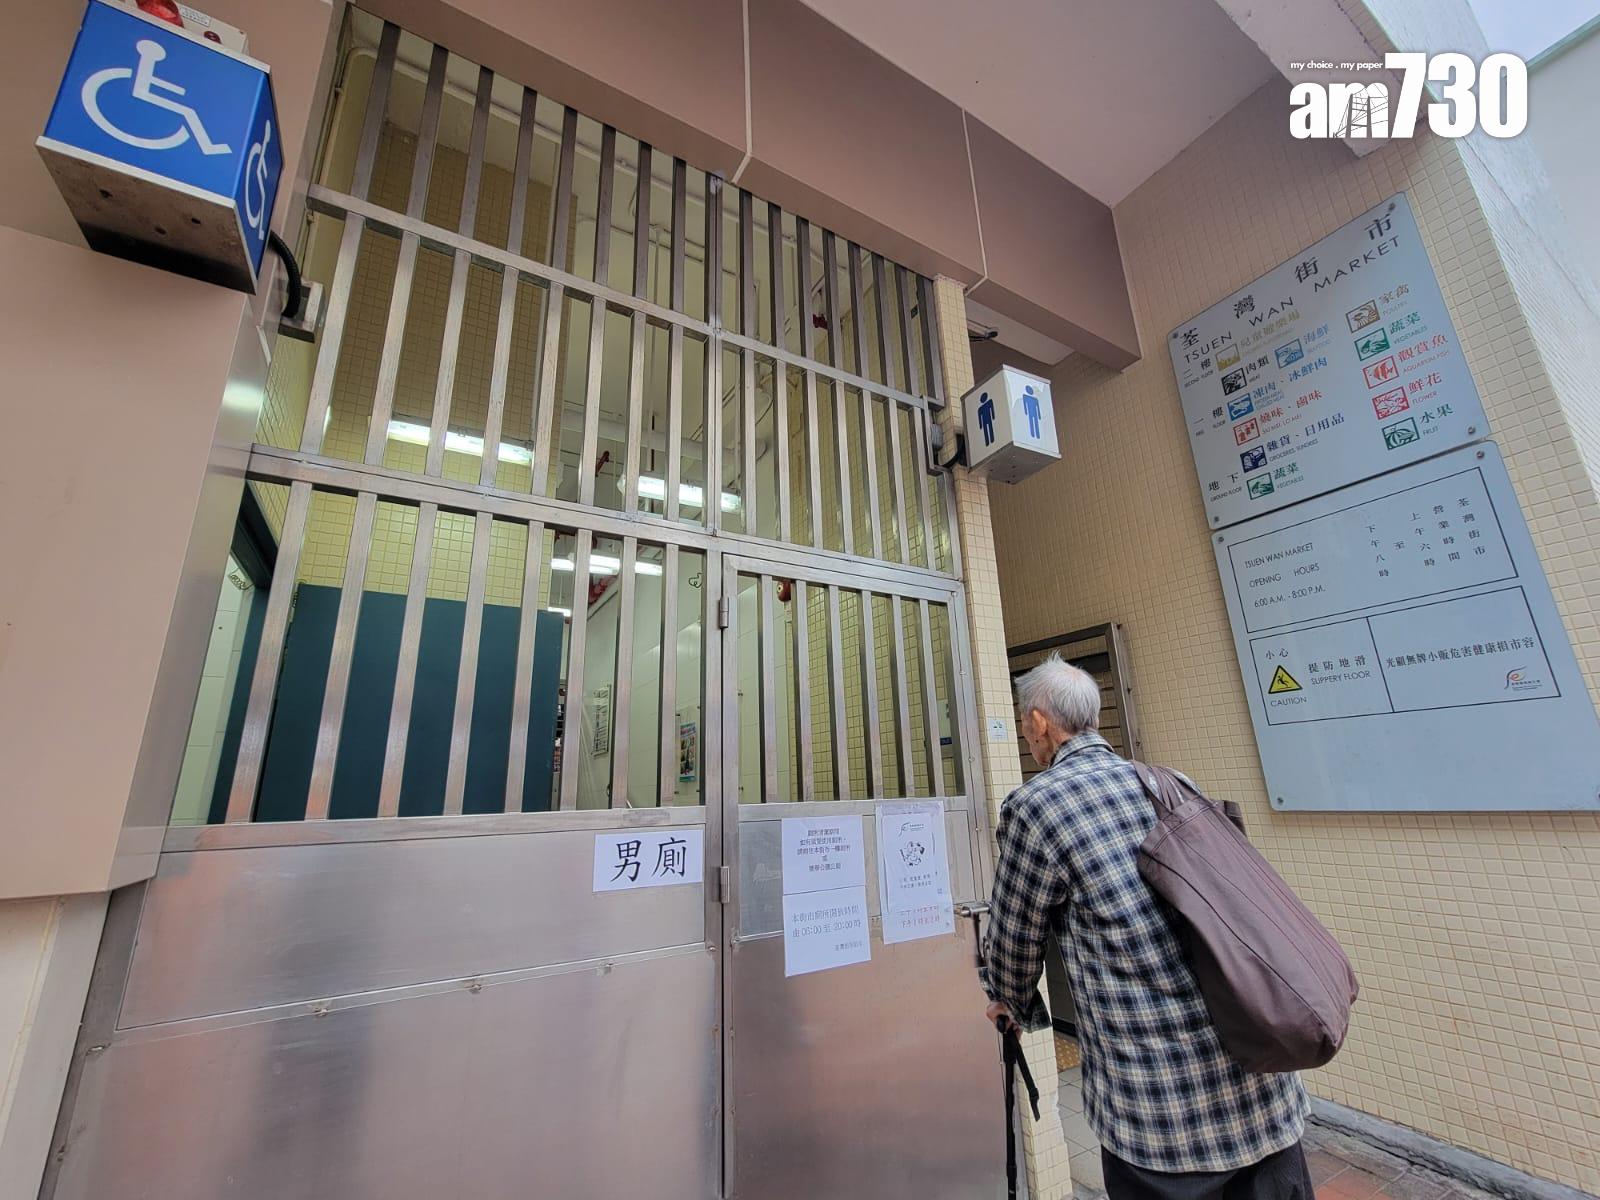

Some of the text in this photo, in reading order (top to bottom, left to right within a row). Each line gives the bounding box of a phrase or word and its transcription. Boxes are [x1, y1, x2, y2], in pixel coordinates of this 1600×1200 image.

[1179, 213, 1392, 351] 荃灣街市
[1184, 331, 1233, 364] TSUEN
[1249, 296, 1294, 326] WAN
[1314, 235, 1401, 293] MARKET
[1389, 311, 1421, 334] 蔬菜
[1397, 334, 1449, 363] 觀賞魚
[1408, 372, 1442, 395] 鮮花
[1412, 391, 1438, 406] FLOWER
[1419, 403, 1454, 424] 水果
[1423, 425, 1439, 437] FRUIT
[1208, 472, 1239, 492] 地下
[1274, 462, 1300, 480] 蔬菜
[1409, 511, 1436, 568] 上午六時
[1432, 504, 1460, 562] 營業時間
[1245, 542, 1314, 569] TSUEN WAN MARKET
[1365, 523, 1389, 578] 下午八時
[1393, 540, 1406, 550] 至
[1249, 562, 1320, 588] OPENING HOURS
[1254, 596, 1269, 608] 6:00
[1269, 593, 1286, 605] A.M.
[1291, 588, 1307, 601] 8:00
[1265, 647, 1289, 660] 小心
[1386, 636, 1535, 668] 光顧無牌小販危害健康損市容
[1308, 655, 1367, 674] 提防地滑
[1344, 669, 1371, 682] FLOOR
[1270, 696, 1307, 708] CAUTION
[610, 837, 687, 884] 男廁
[801, 925, 822, 937] 06:00
